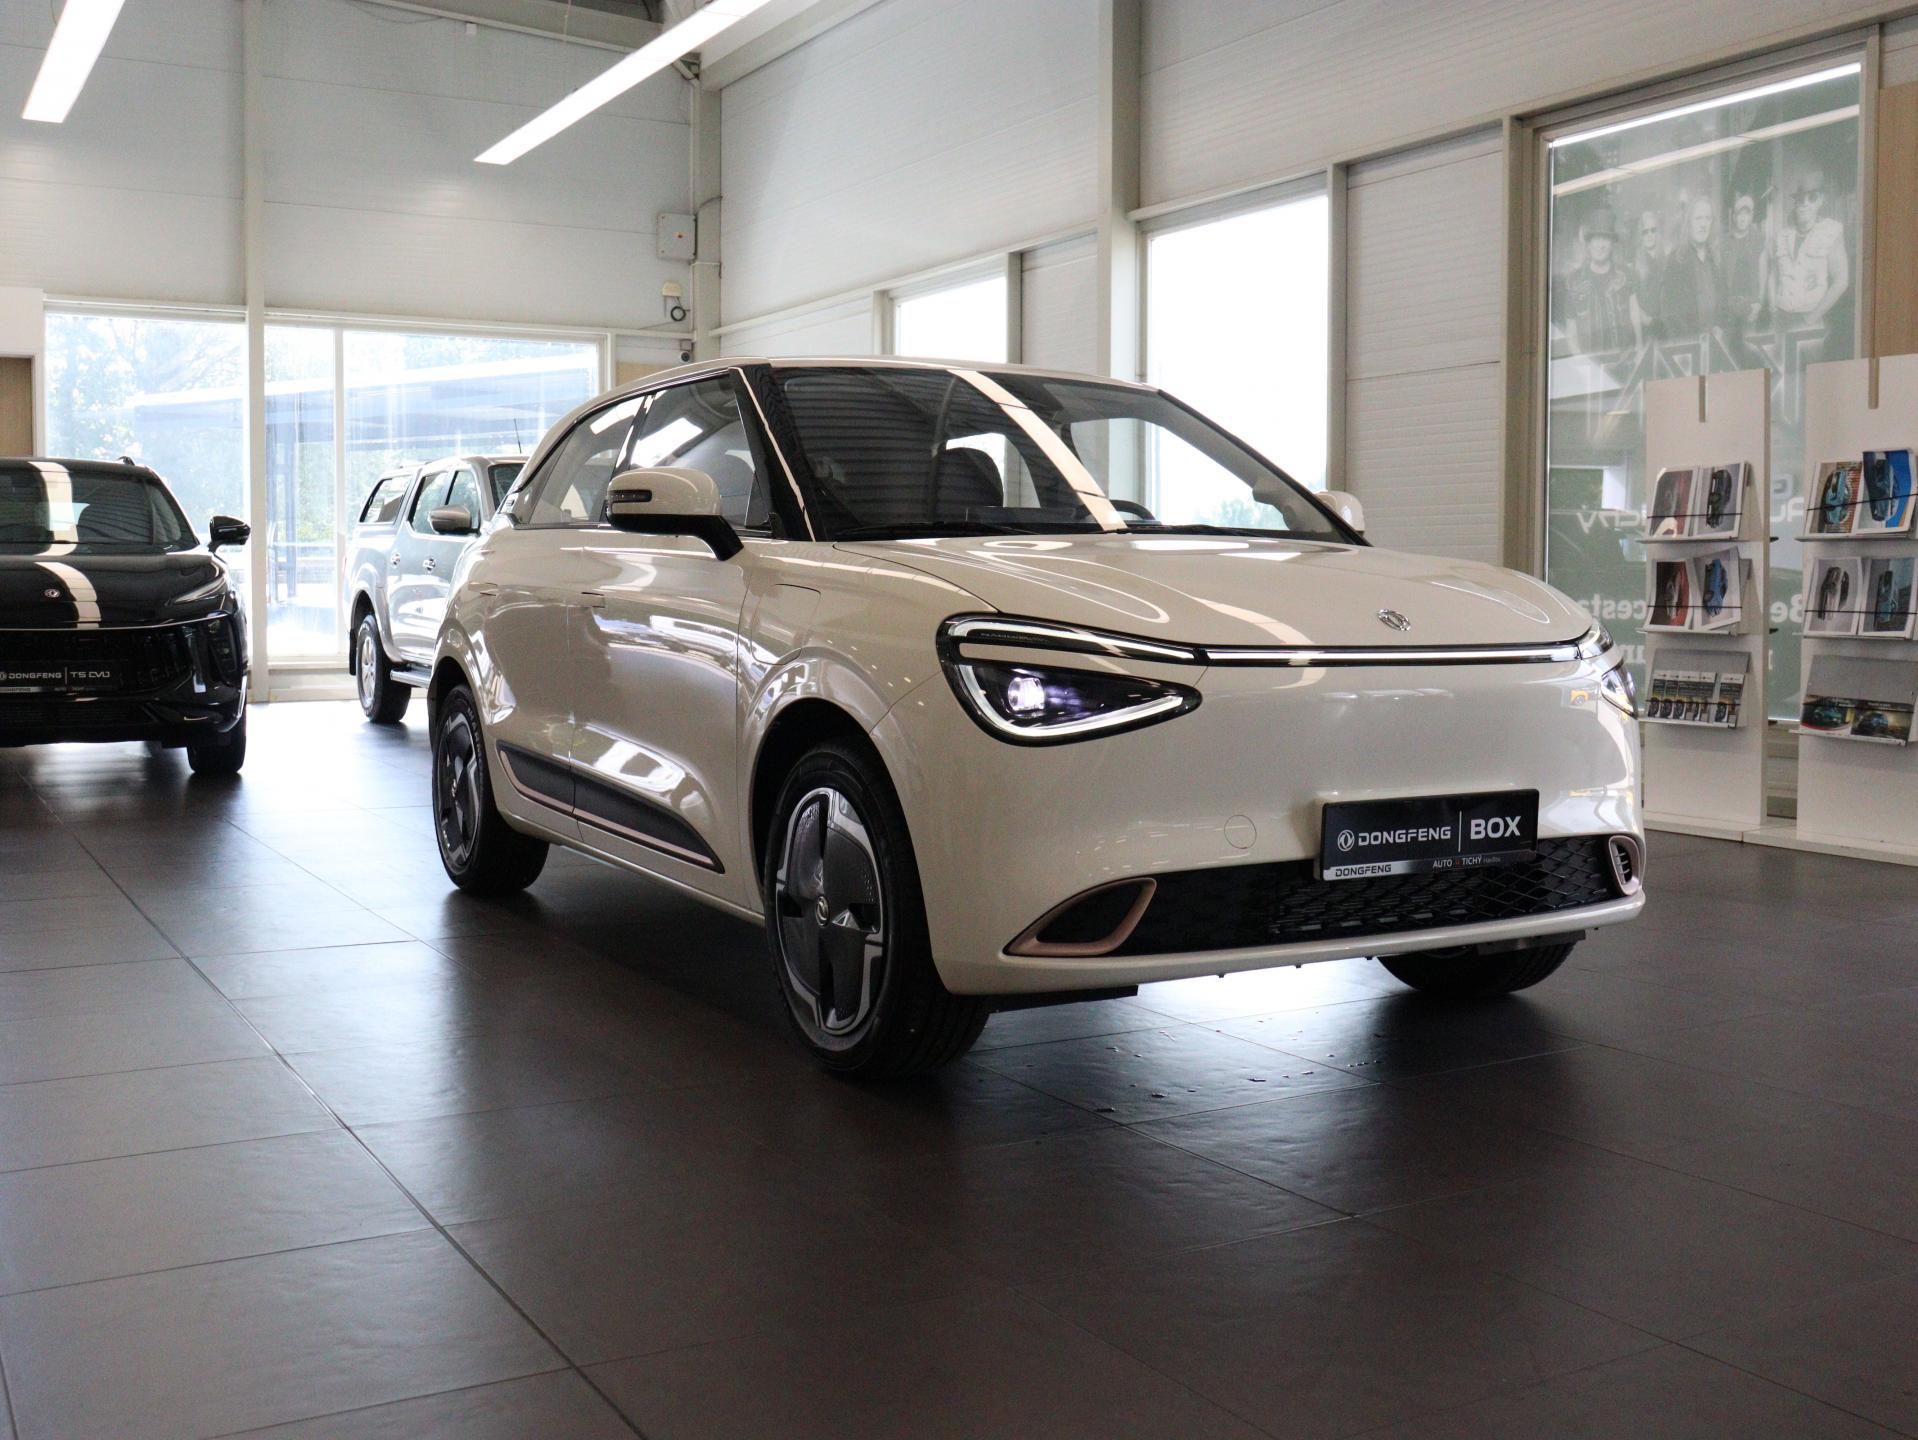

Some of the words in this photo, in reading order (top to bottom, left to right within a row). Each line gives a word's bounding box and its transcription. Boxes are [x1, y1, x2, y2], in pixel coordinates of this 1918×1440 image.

[8, 671, 62, 680] DONGFENG
[1358, 826, 1452, 847] DONGFENG
[1470, 815, 1521, 840] BOX
[1335, 864, 1392, 878] DONGFENG
[1432, 858, 1453, 869] AUTO
